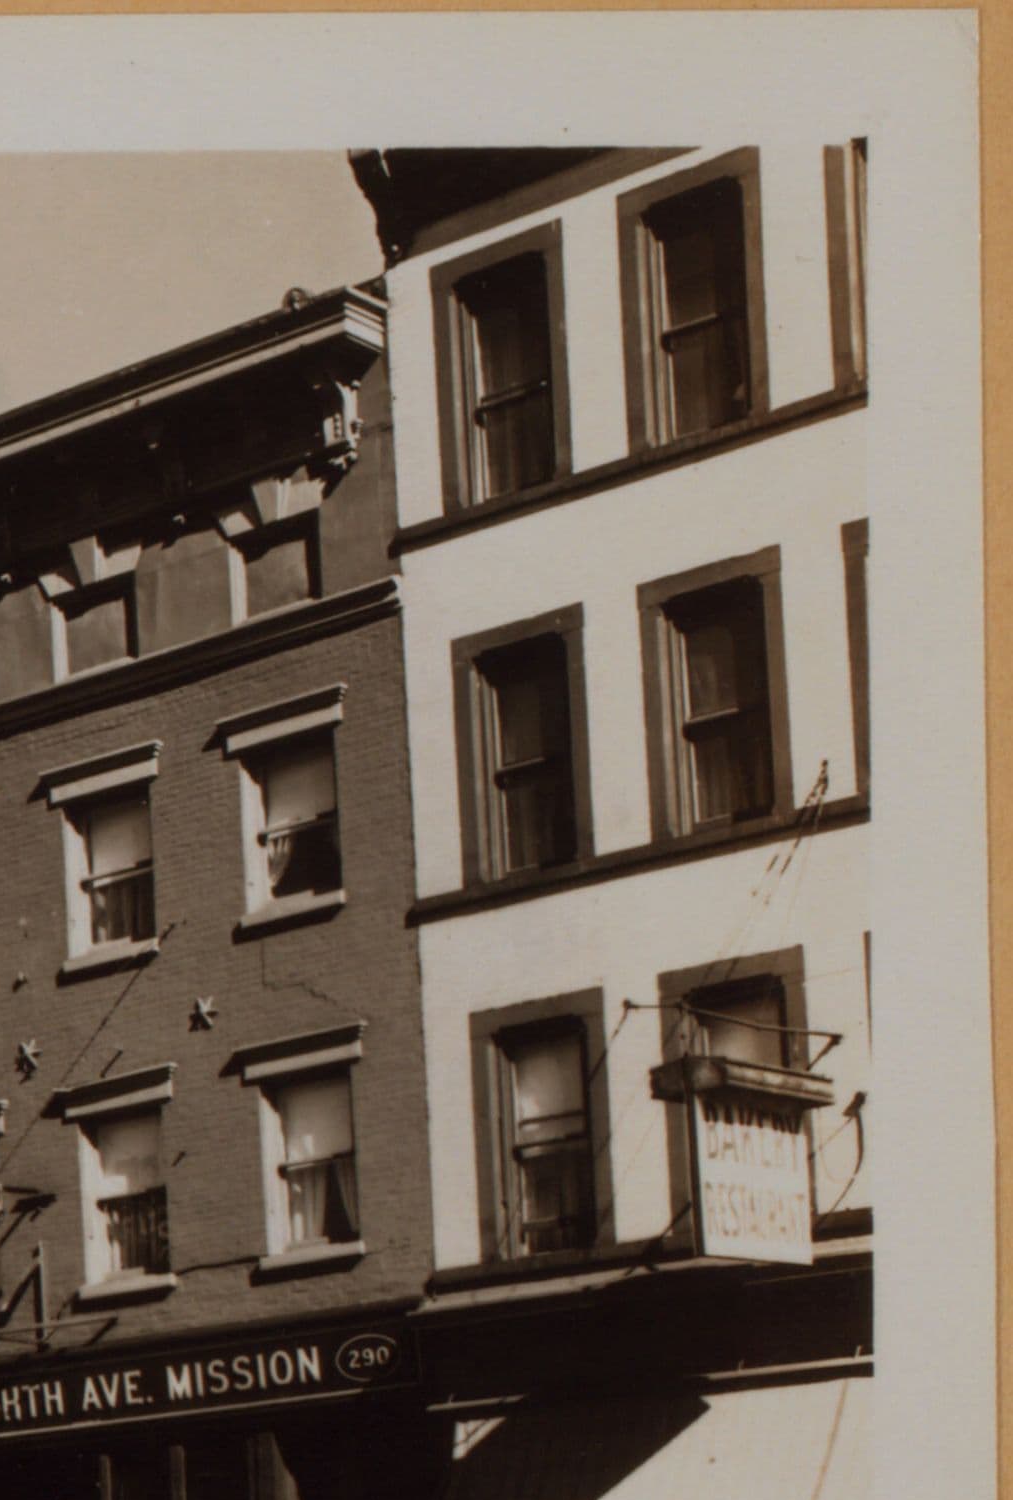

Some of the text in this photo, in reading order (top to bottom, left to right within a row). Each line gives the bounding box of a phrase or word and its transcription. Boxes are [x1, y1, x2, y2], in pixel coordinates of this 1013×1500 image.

[81, 1369, 154, 1412] AVE.
[164, 1346, 323, 1401] MISSION
[347, 1346, 390, 1370] 290
